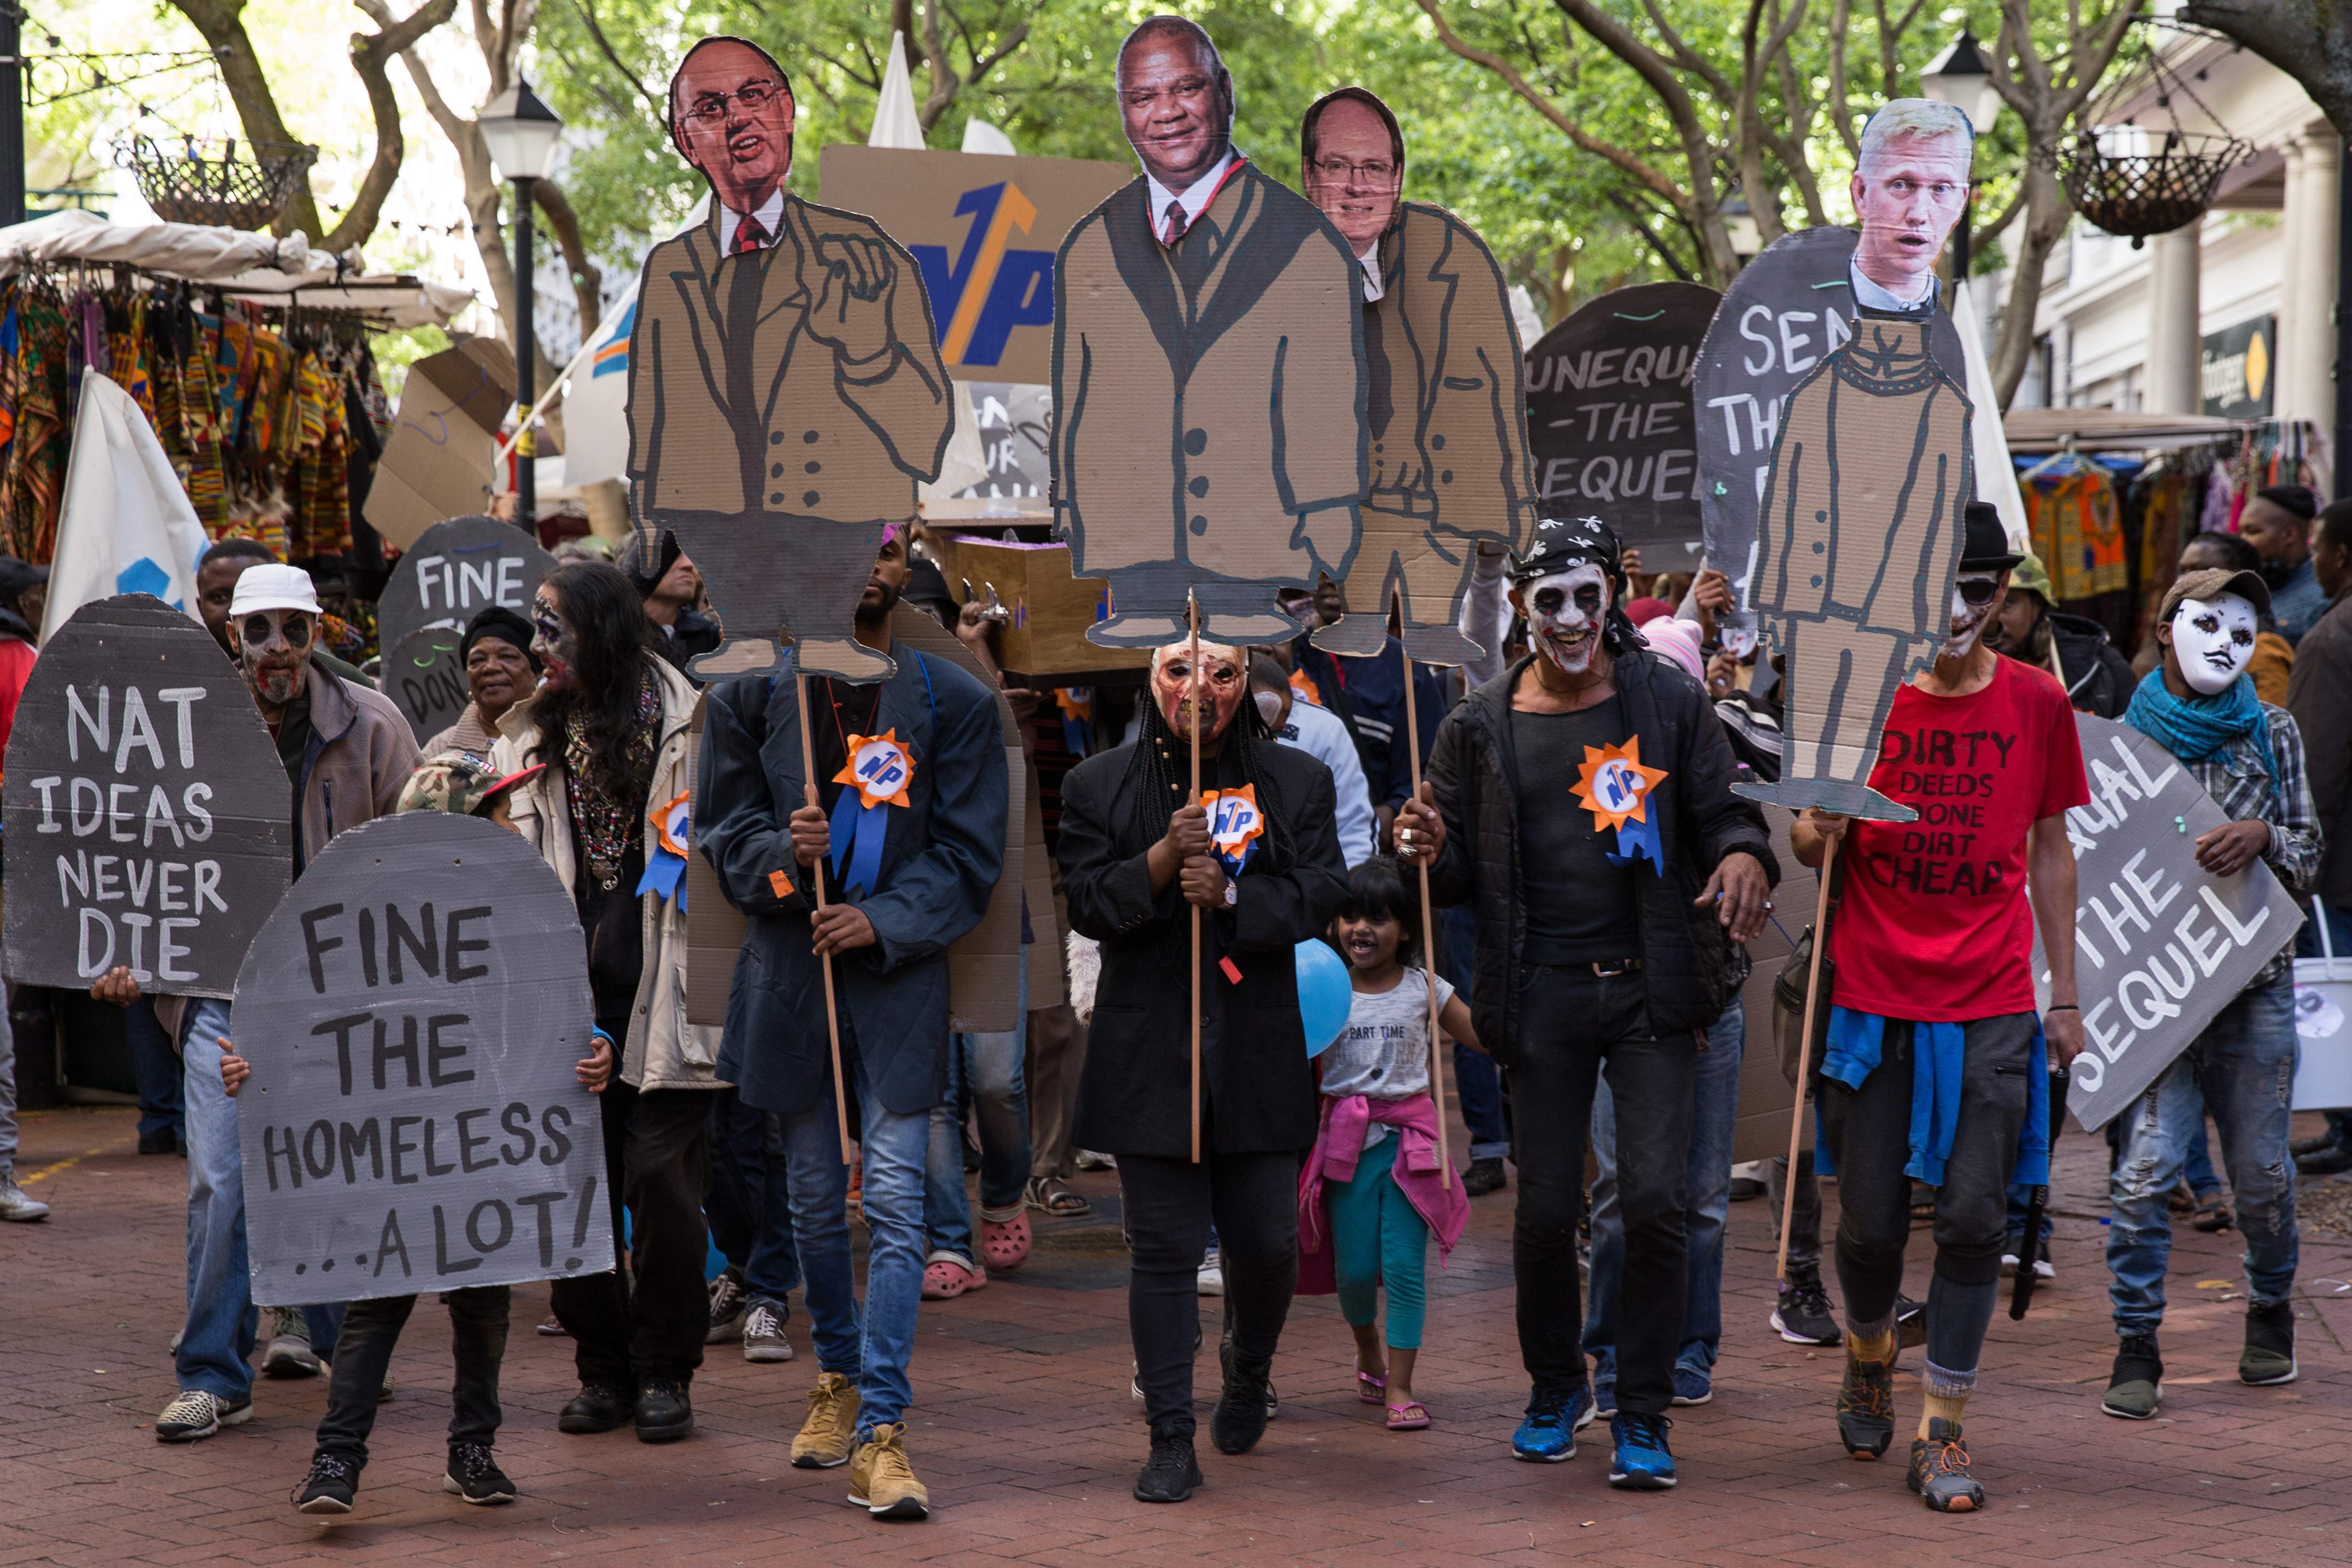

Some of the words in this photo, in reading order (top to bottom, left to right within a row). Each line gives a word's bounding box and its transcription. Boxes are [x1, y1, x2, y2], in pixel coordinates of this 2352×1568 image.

[1526, 345, 1693, 393] UNEQU
[1739, 304, 1862, 376] SEN
[1707, 394, 1789, 456] TH
[1531, 449, 1702, 501] EQUE
[417, 555, 525, 609] FINE
[402, 653, 470, 725] DON'
[66, 684, 206, 773] NAT
[1879, 728, 2017, 769] DIRTY
[30, 776, 213, 848] IDEAS
[1900, 771, 1994, 797] DEEDS
[1866, 851, 2003, 897] CHEAP
[1902, 832, 1975, 857] DIRT
[56, 849, 228, 915] NEVER
[77, 907, 200, 982] DIE
[300, 903, 492, 993] FINE
[311, 1013, 475, 1095] THE
[1350, 1026, 1375, 1039] PART
[1380, 1025, 1405, 1039] TIME
[263, 1102, 573, 1191] HOMELESS
[433, 1176, 596, 1276] LOT!
